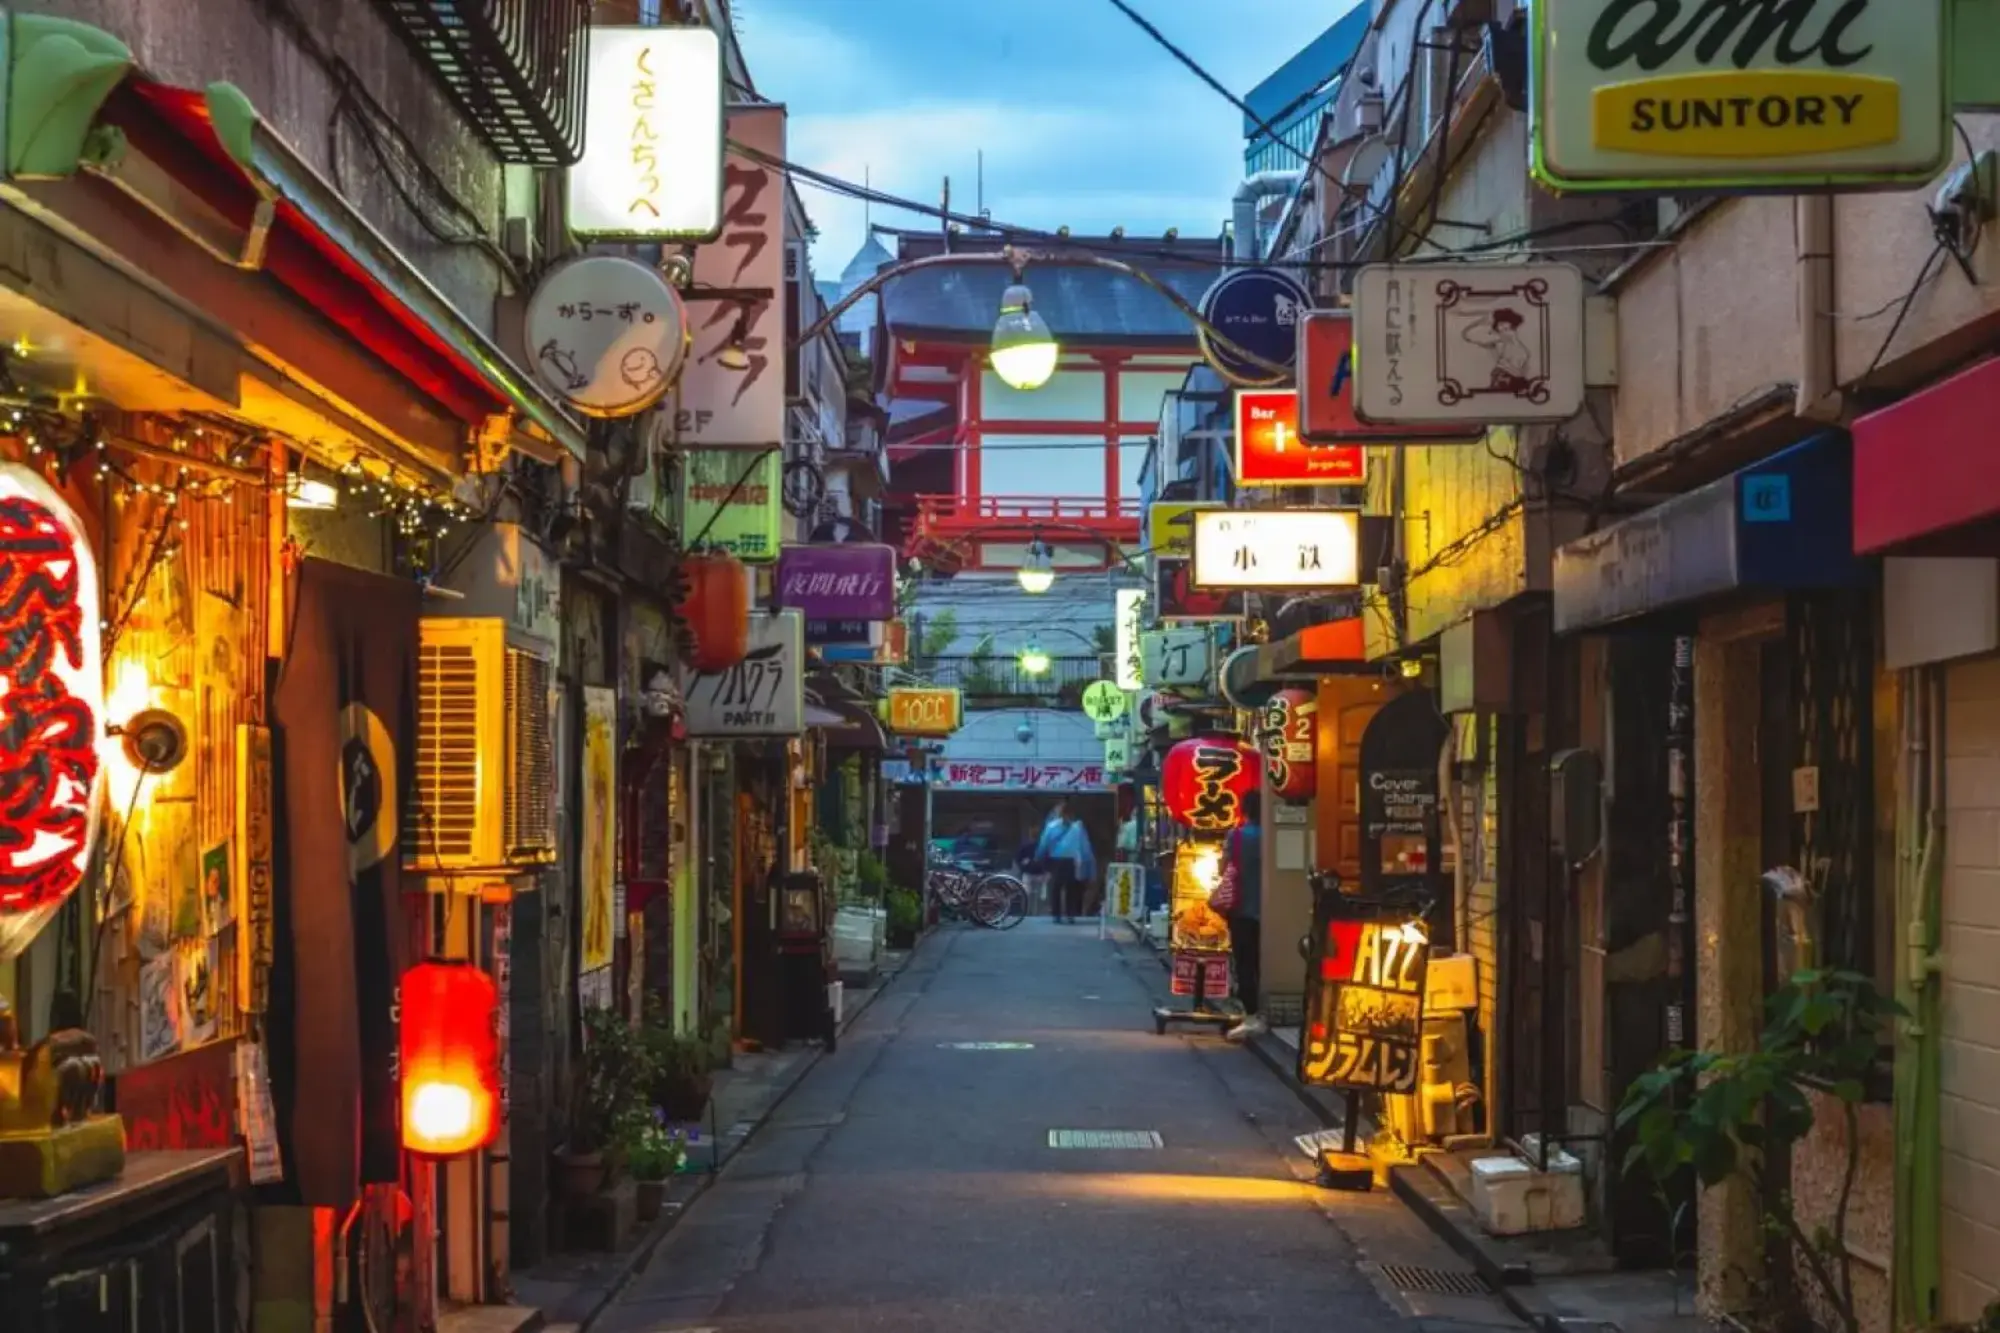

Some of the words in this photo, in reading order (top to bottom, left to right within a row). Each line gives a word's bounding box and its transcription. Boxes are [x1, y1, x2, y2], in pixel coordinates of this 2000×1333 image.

[1630, 94, 1864, 131] SUNTORY
[1251, 406, 1275, 419] Bar
[722, 711, 763, 726] PART
[950, 763, 1103, 785] 新宿ゴールデン街
[1370, 772, 1420, 790] Cover
[1322, 919, 1425, 991] JAZZ
